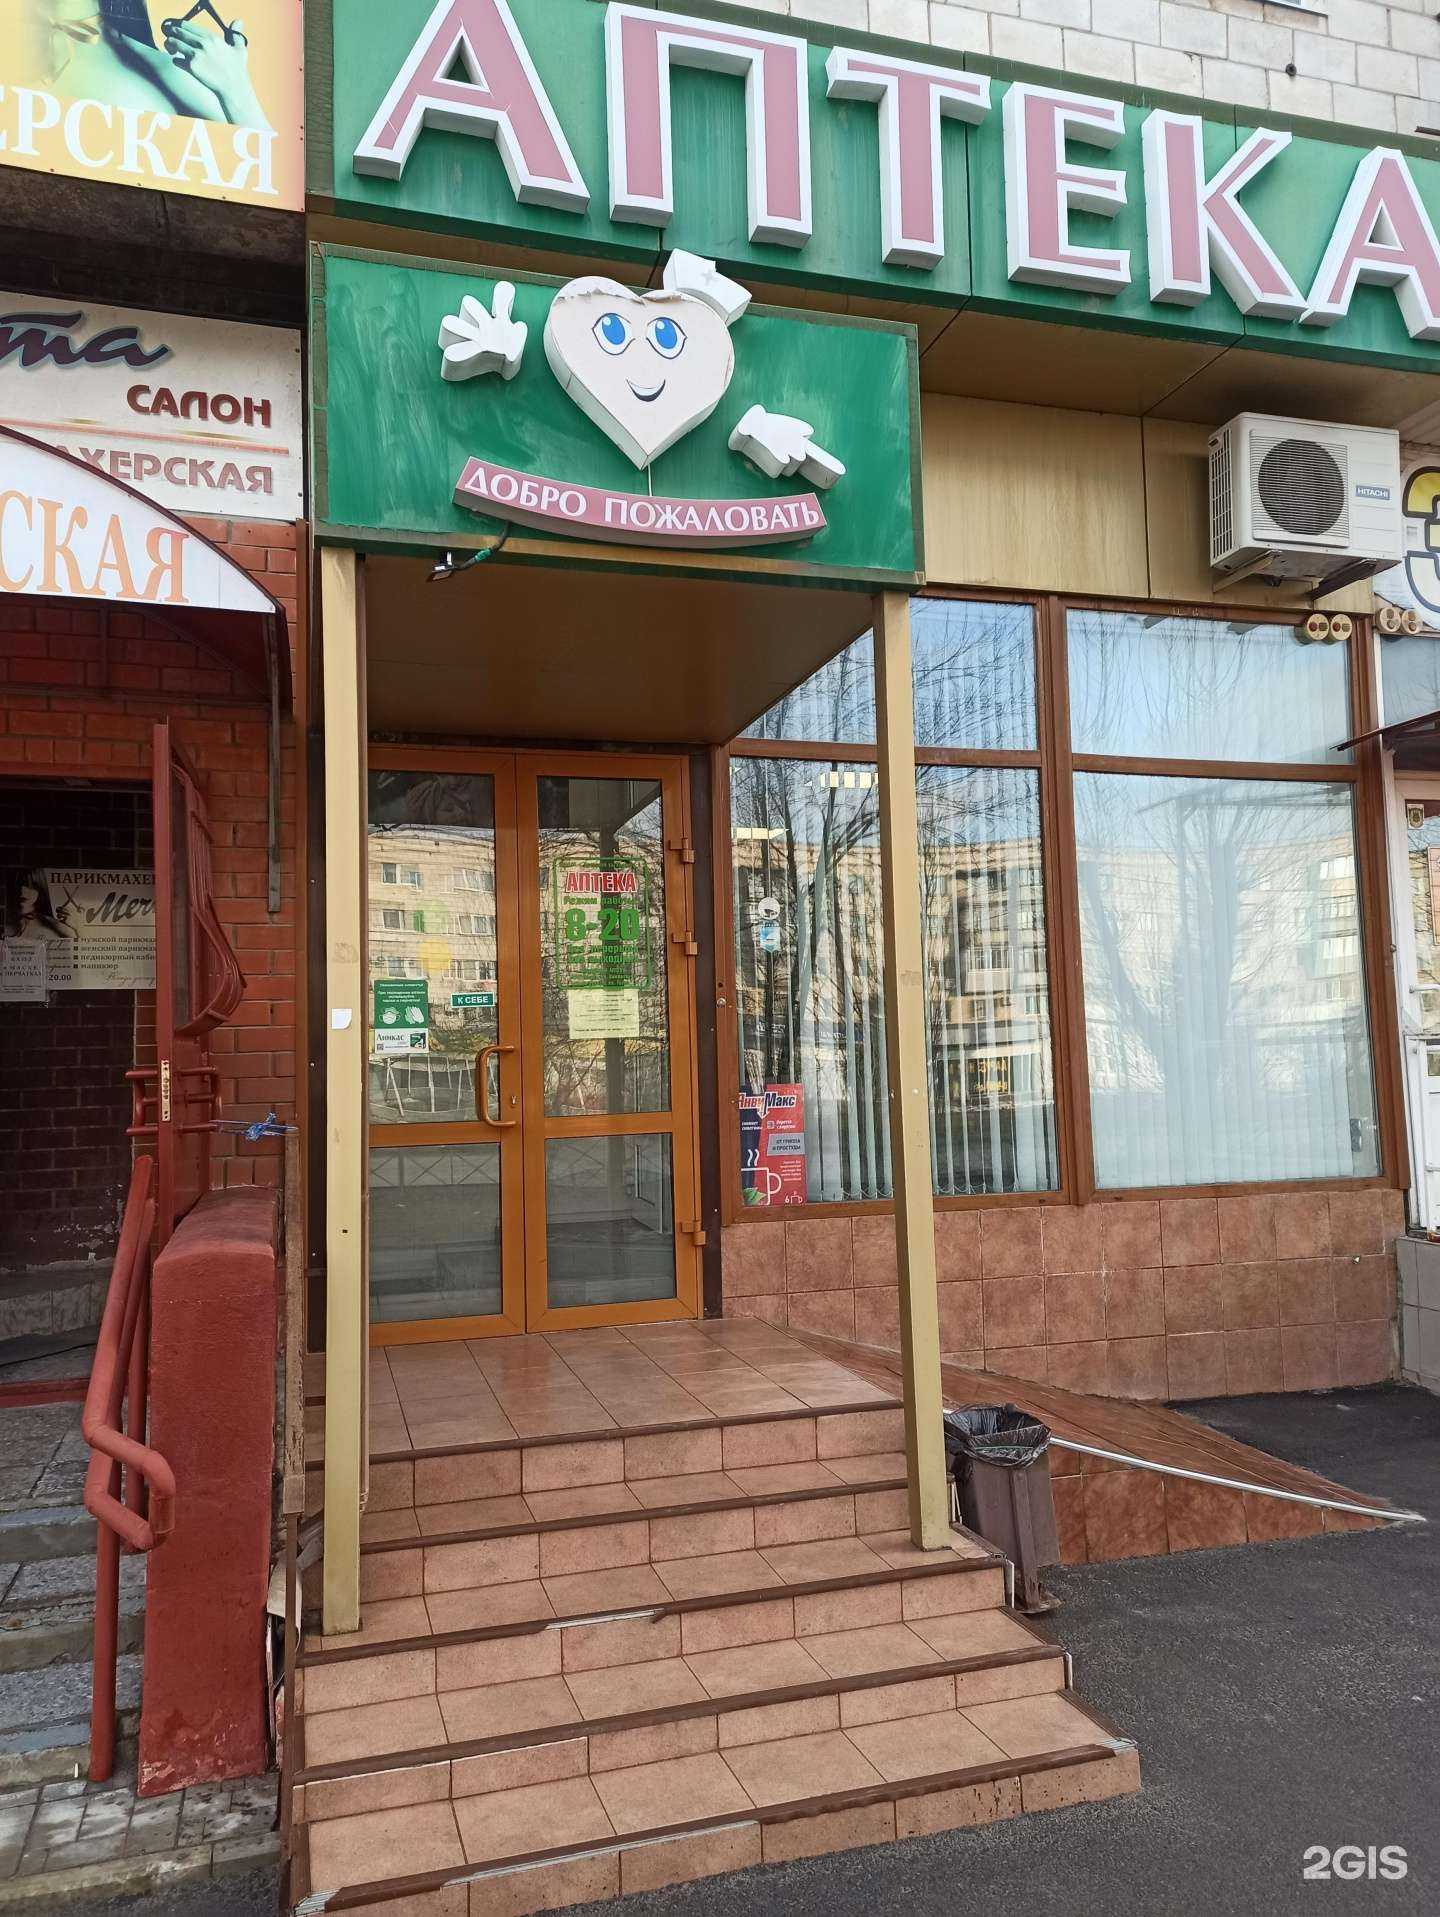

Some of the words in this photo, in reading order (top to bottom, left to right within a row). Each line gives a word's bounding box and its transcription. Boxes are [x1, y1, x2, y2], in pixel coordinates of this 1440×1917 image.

[0, 85, 279, 195] РСКАЯ
[353, 0, 1440, 344] АПТЕКА
[126, 384, 271, 427] САЛОН
[57, 445, 273, 494] ХЕРСКАЯ
[1356, 487, 1389, 498] HITACHI
[464, 466, 588, 517] ДОБРО
[603, 497, 821, 533] ПОЖАЛОВАТЬ
[0, 490, 189, 603] СКАЯ
[565, 871, 637, 893] АПТЕКА
[465, 996, 489, 1004] СЕБЕ
